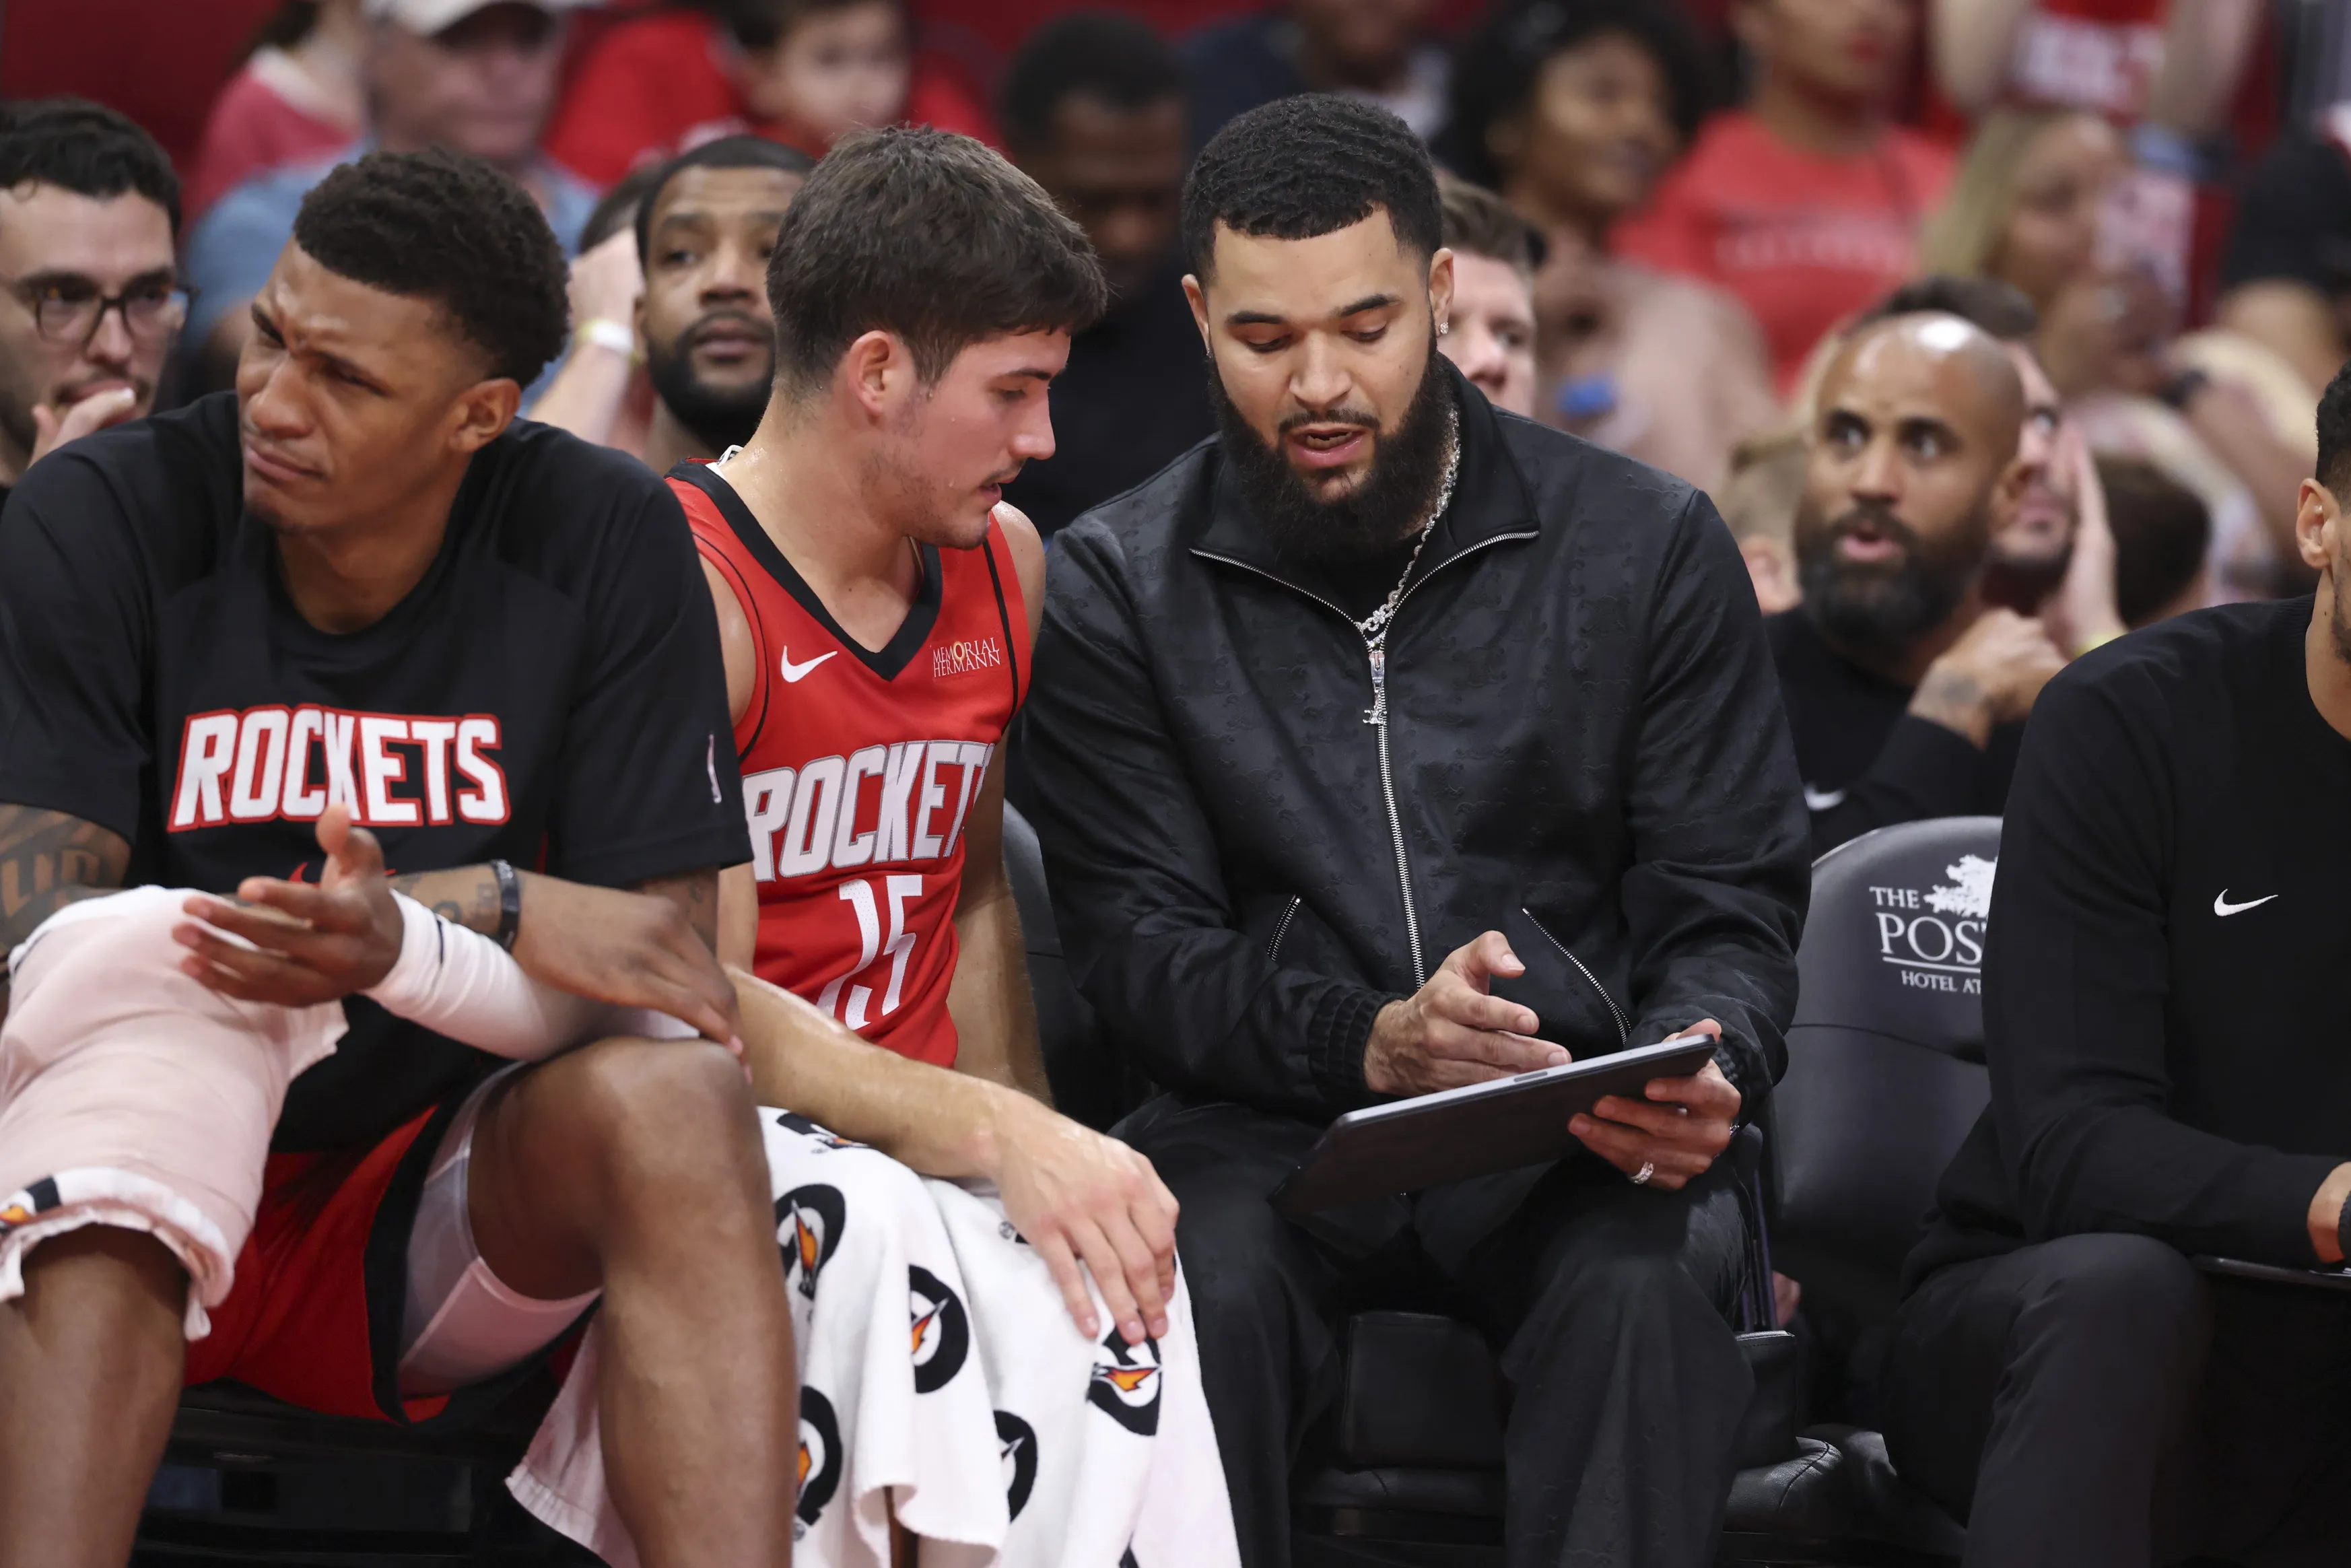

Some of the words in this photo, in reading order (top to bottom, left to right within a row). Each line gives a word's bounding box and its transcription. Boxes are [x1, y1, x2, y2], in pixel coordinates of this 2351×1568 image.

[933, 637, 1000, 663] MEMORIAL
[933, 650, 1000, 678] HERMANN
[168, 704, 510, 832] ROCKETS
[743, 739, 995, 882] ROCKET
[1869, 886, 1919, 908] THE
[1876, 912, 1986, 965] POS
[1901, 970, 1957, 992] HOTEL
